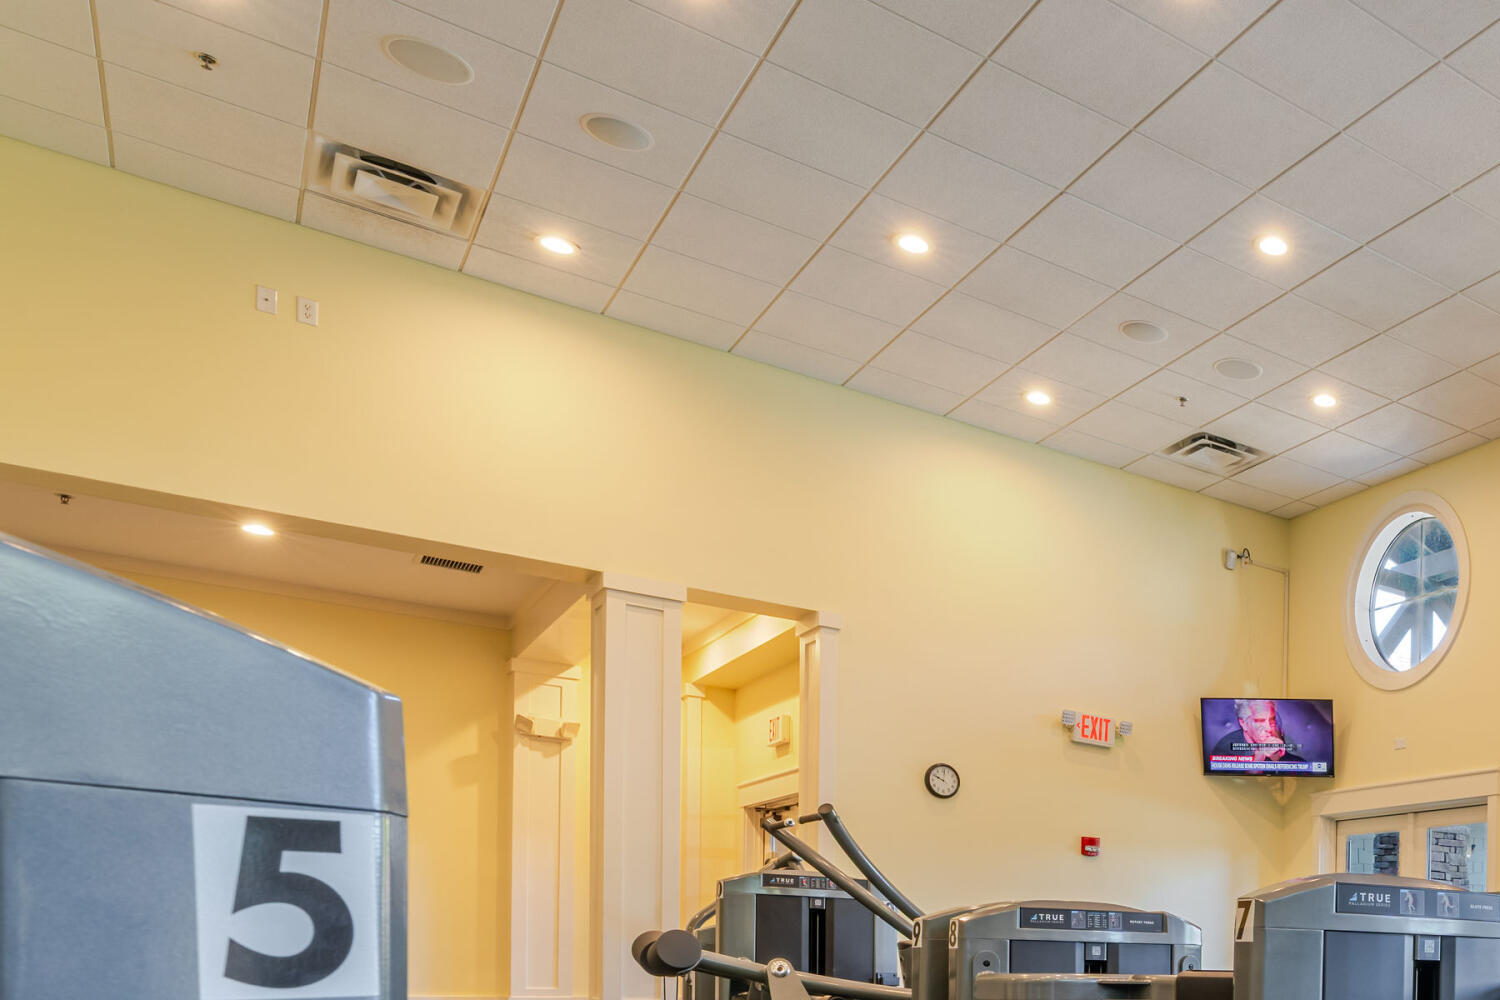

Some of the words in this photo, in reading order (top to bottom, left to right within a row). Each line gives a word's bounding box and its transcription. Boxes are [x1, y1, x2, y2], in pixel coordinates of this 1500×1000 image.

[1081, 714, 1111, 742] EXIT
[223, 815, 354, 989] 5
[1359, 892, 1391, 903] TRUE
[1039, 913, 1065, 921] TRUE
[1236, 900, 1253, 940] 7
[913, 921, 921, 946] 9
[950, 921, 956, 947] 8
